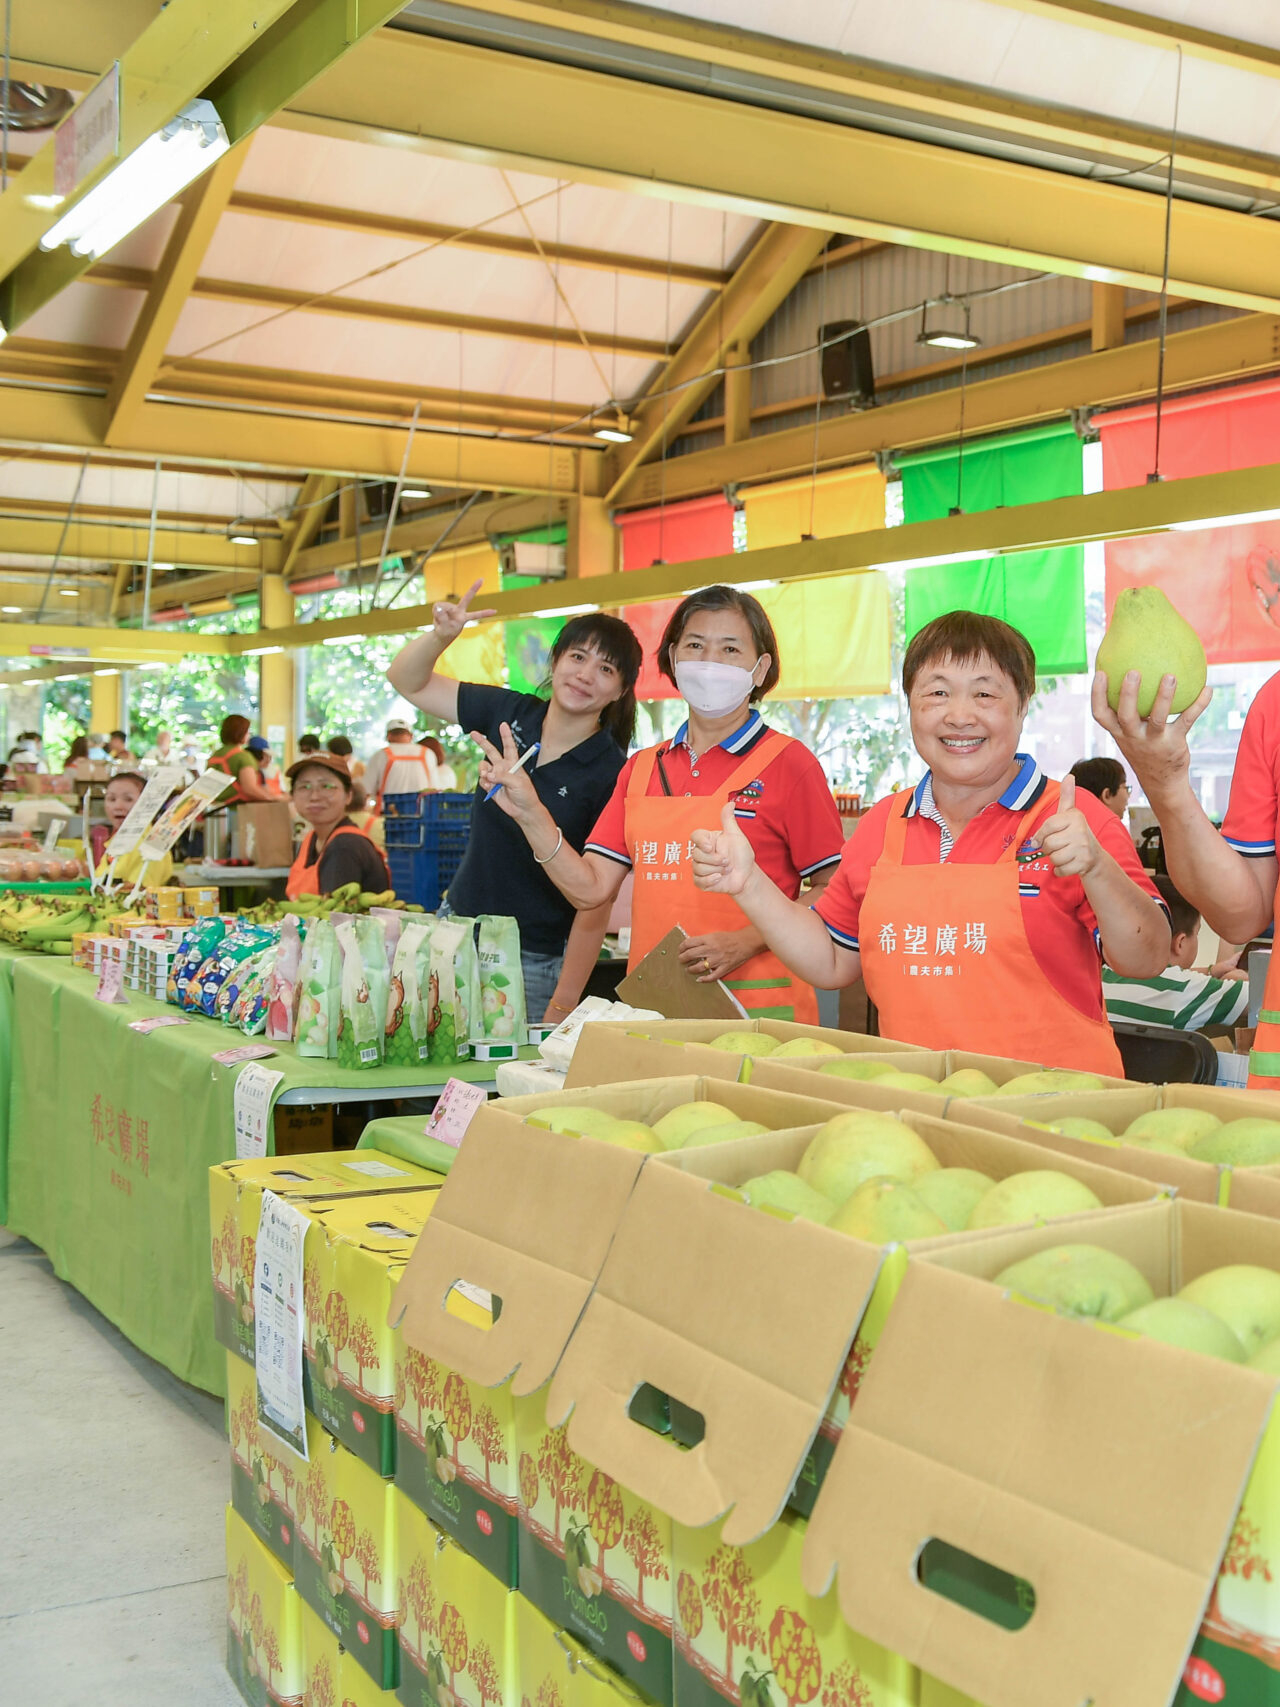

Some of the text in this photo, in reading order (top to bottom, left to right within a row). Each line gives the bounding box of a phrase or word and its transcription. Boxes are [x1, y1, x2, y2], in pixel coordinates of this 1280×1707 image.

[877, 922, 988, 957] 希望廣場
[909, 965, 954, 977] 農夫市集
[90, 1093, 150, 1179] 希望廣場
[561, 1576, 608, 1632] Pomelo
